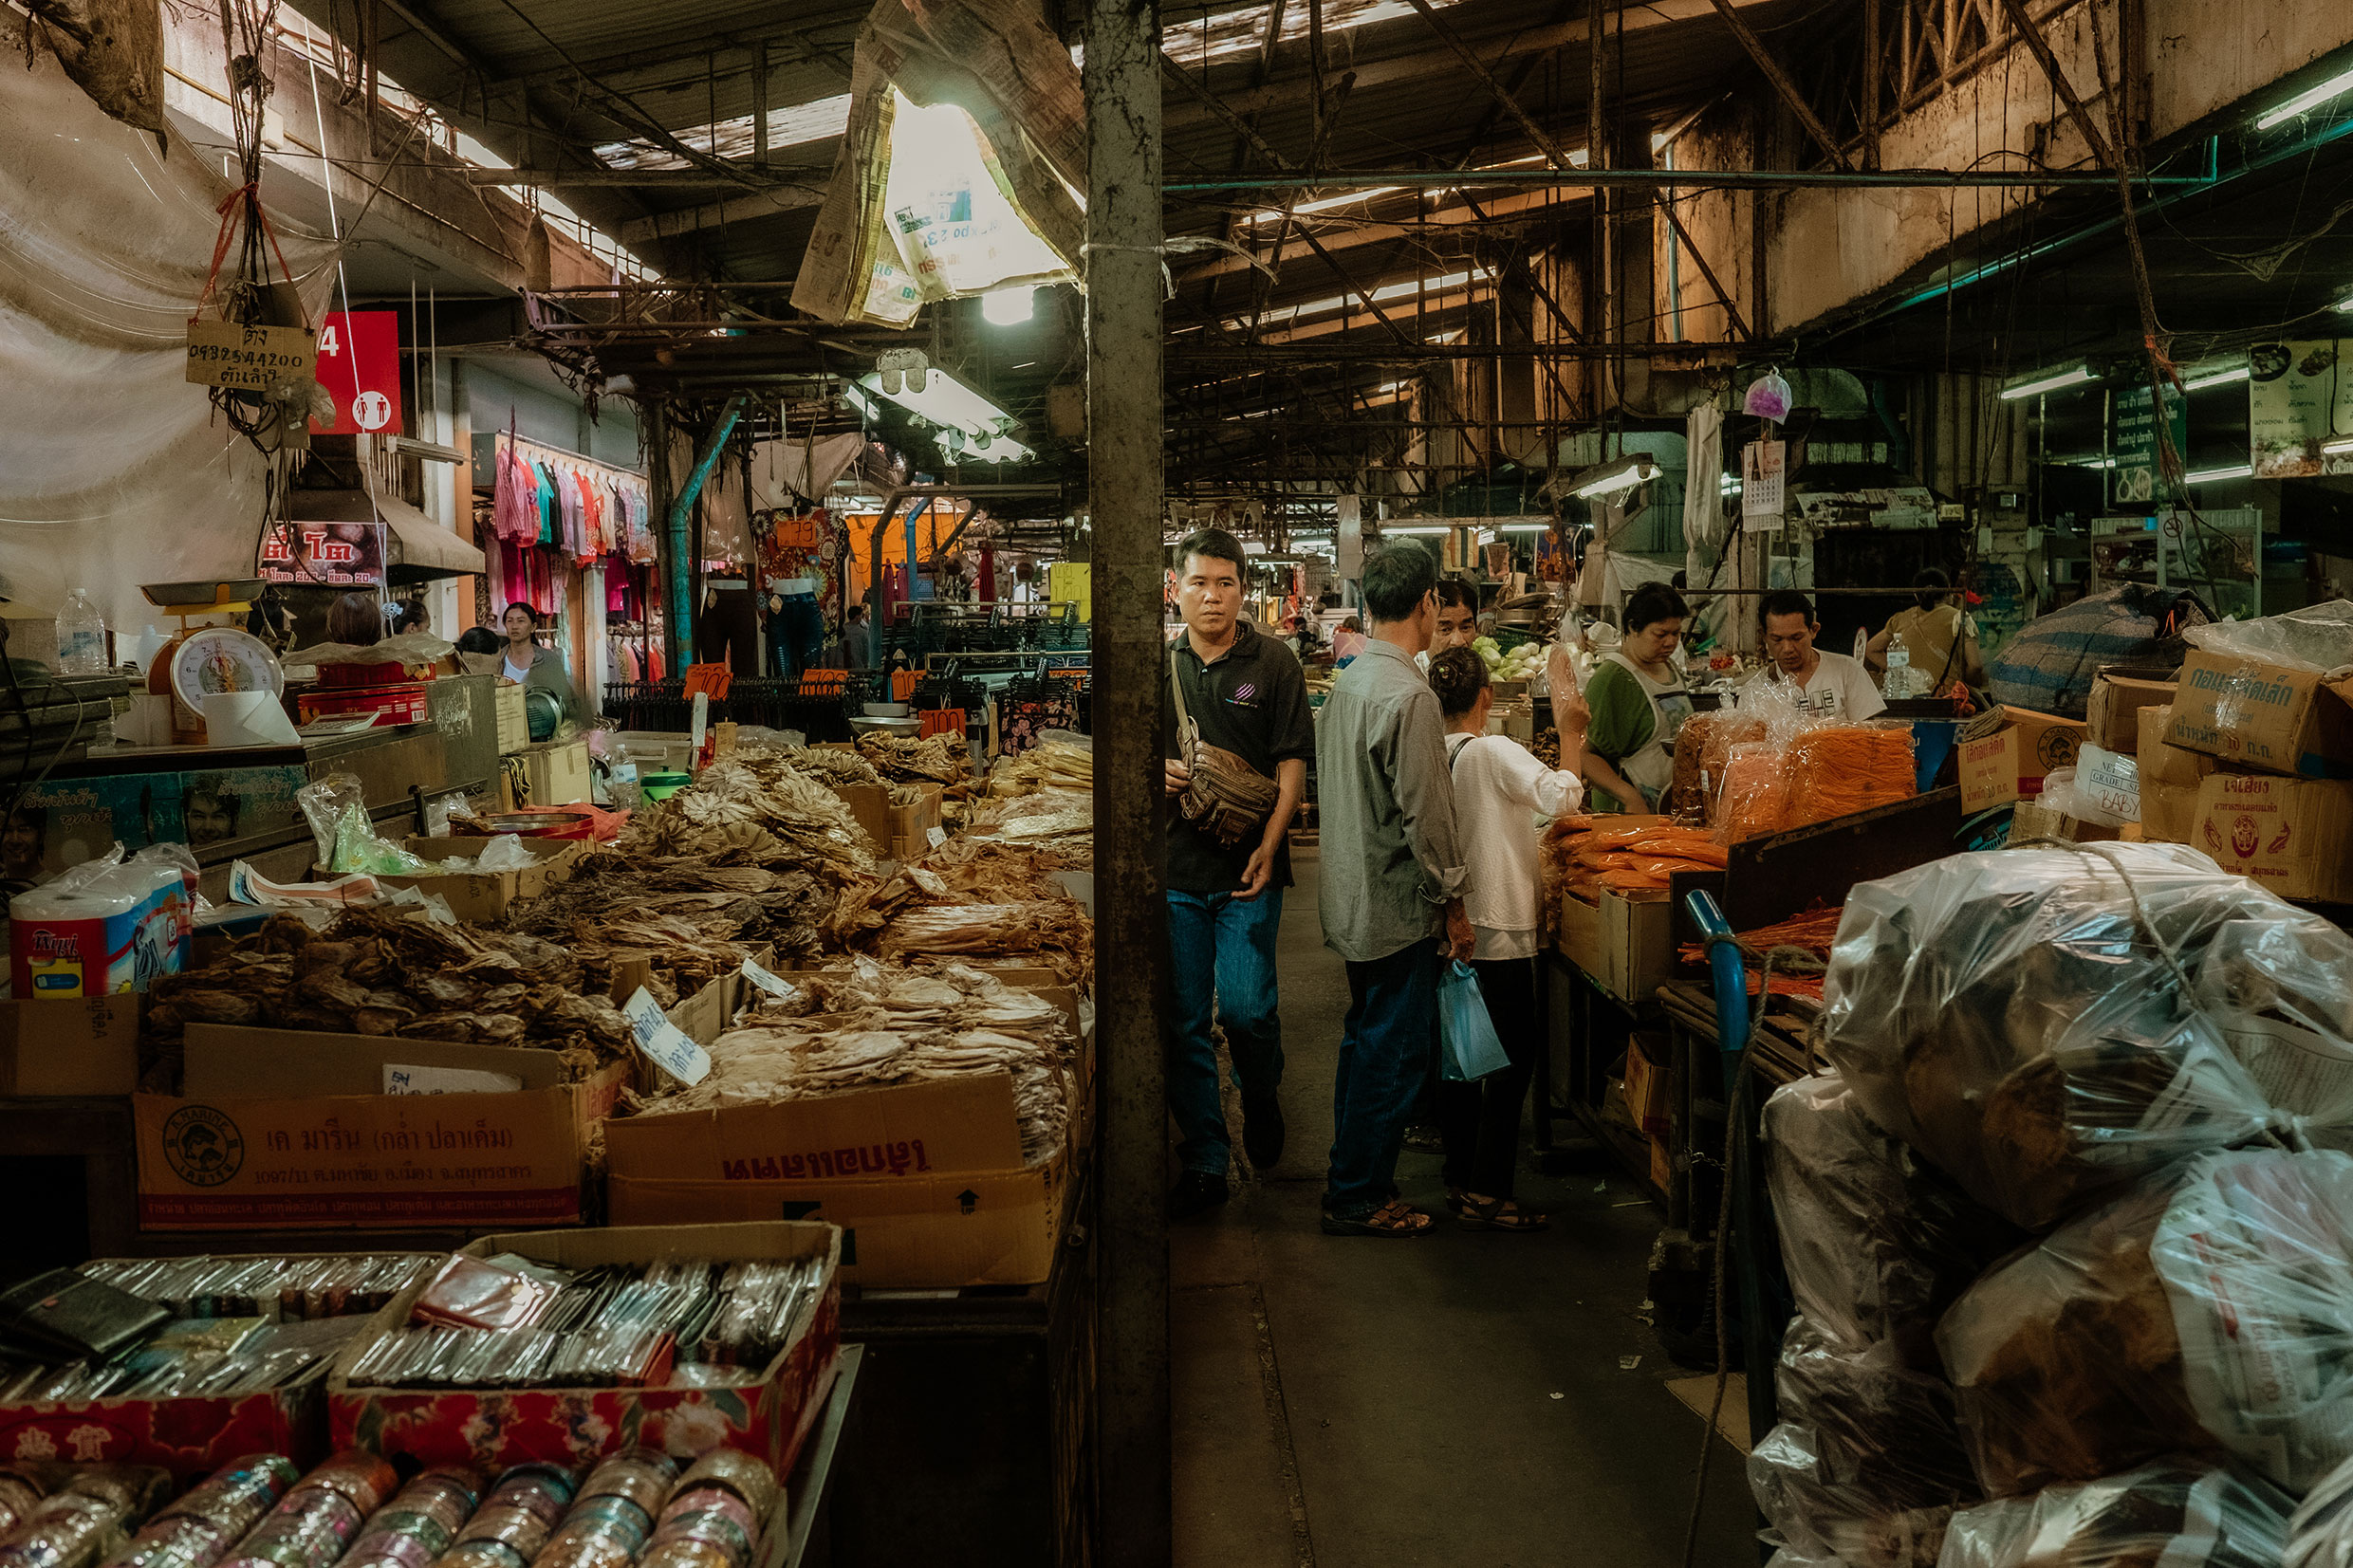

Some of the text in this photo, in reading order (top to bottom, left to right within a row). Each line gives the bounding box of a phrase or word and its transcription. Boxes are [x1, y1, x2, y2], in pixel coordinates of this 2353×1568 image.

[320, 325, 340, 357] 4
[790, 522, 813, 542] 79
[2093, 772, 2121, 787] GRADE
[2099, 789, 2141, 816] BABY
